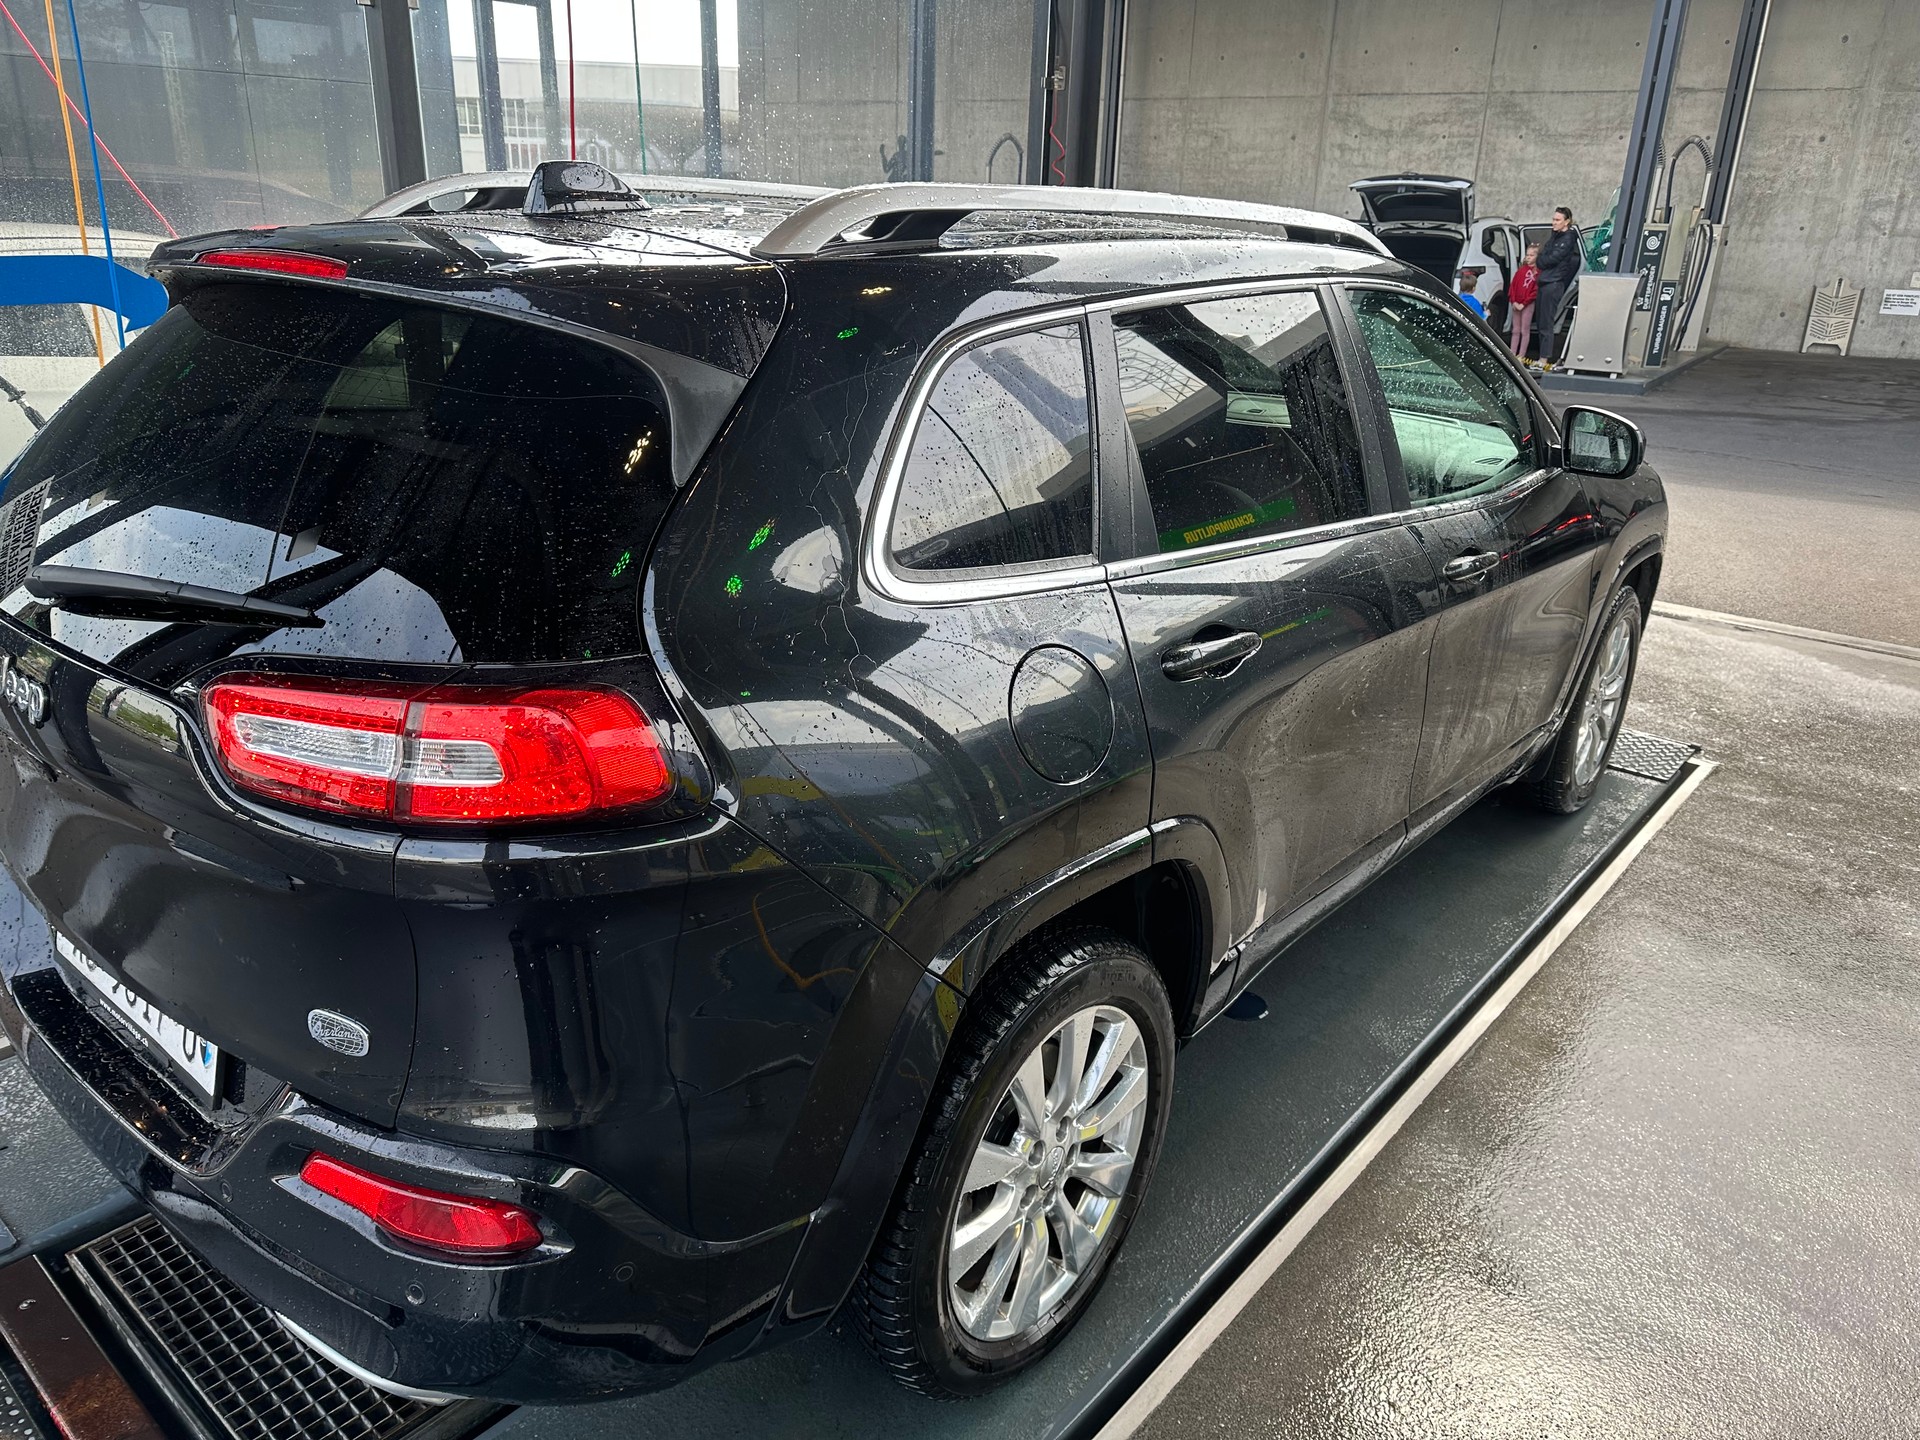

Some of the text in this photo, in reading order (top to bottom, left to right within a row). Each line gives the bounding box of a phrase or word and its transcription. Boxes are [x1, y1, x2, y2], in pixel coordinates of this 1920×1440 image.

[1643, 265, 1656, 310] DUFTSPENDER
[1652, 305, 1668, 354] TURBO-SAUGER
[99, 998, 149, 1048] www.motorvillage.ch
[312, 1020, 362, 1042] Overland
